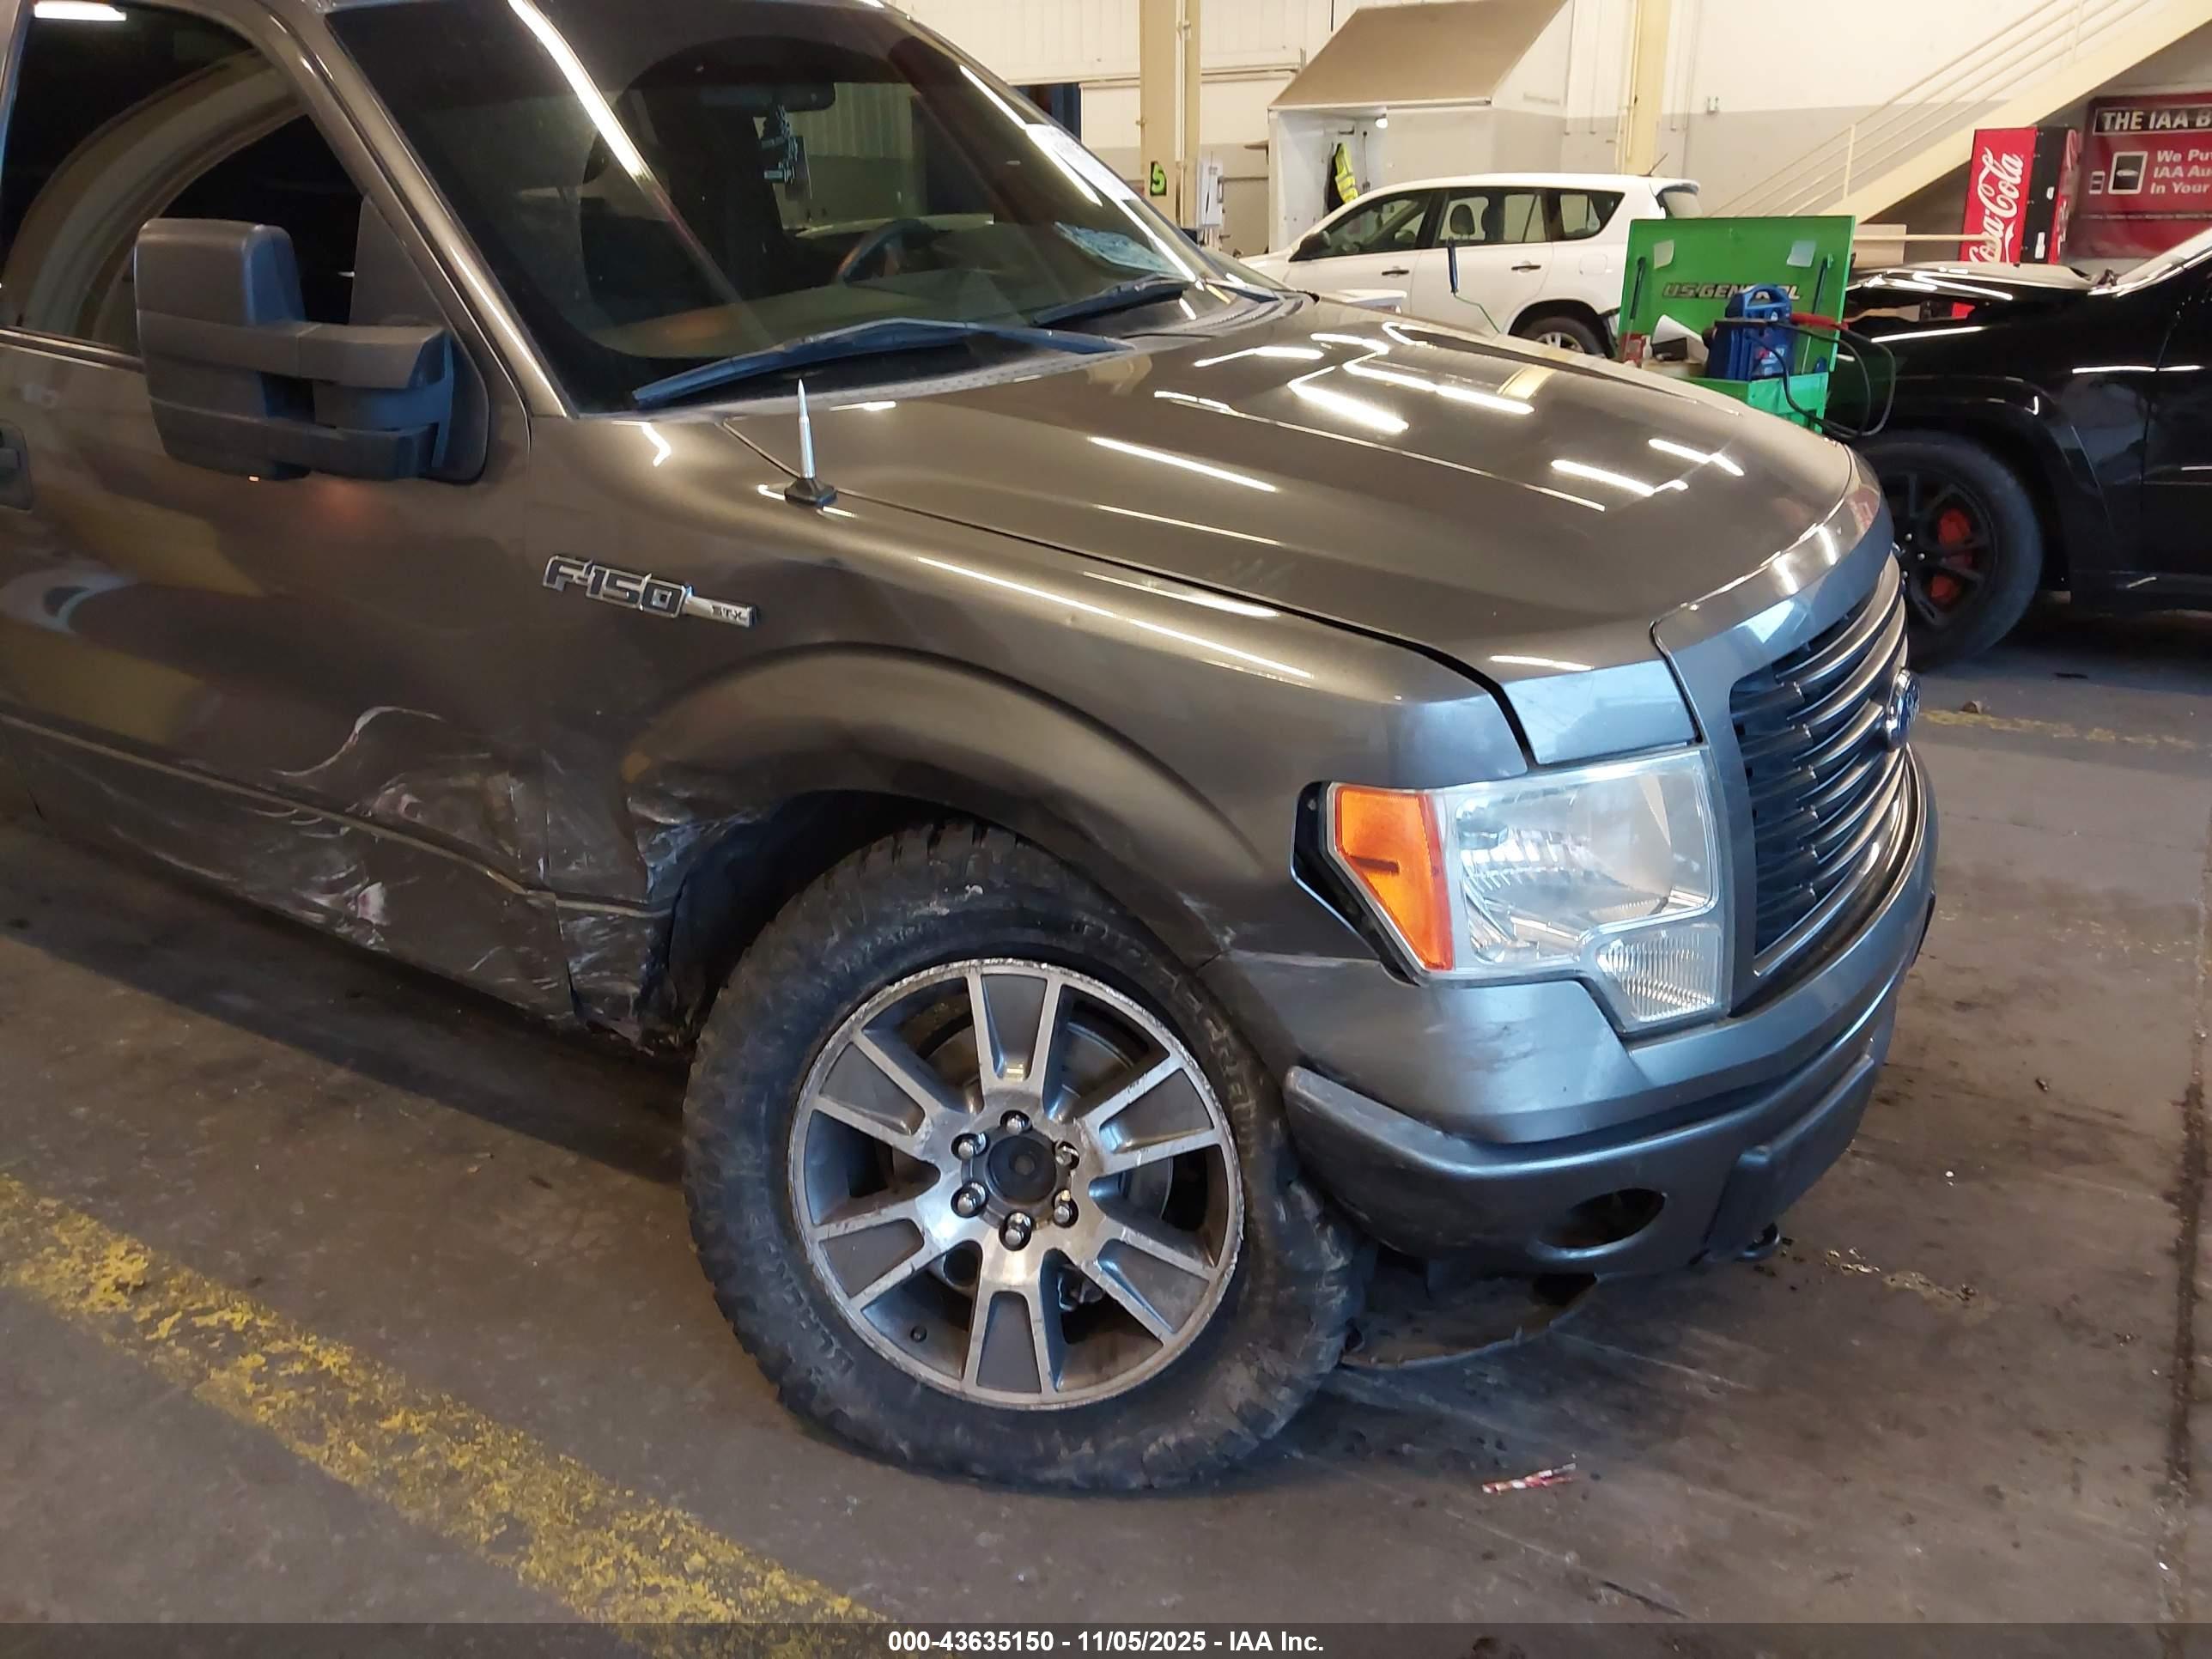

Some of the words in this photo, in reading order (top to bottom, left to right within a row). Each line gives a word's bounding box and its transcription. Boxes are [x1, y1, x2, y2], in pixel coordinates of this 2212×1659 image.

[2103, 111, 2144, 131] THE
[2148, 110, 2189, 130] IAA
[2156, 150, 2182, 162] We
[1152, 162, 1166, 194] 5
[2153, 166, 2184, 179] IAA
[2150, 182, 2166, 194] In
[2172, 181, 2211, 193] Your
